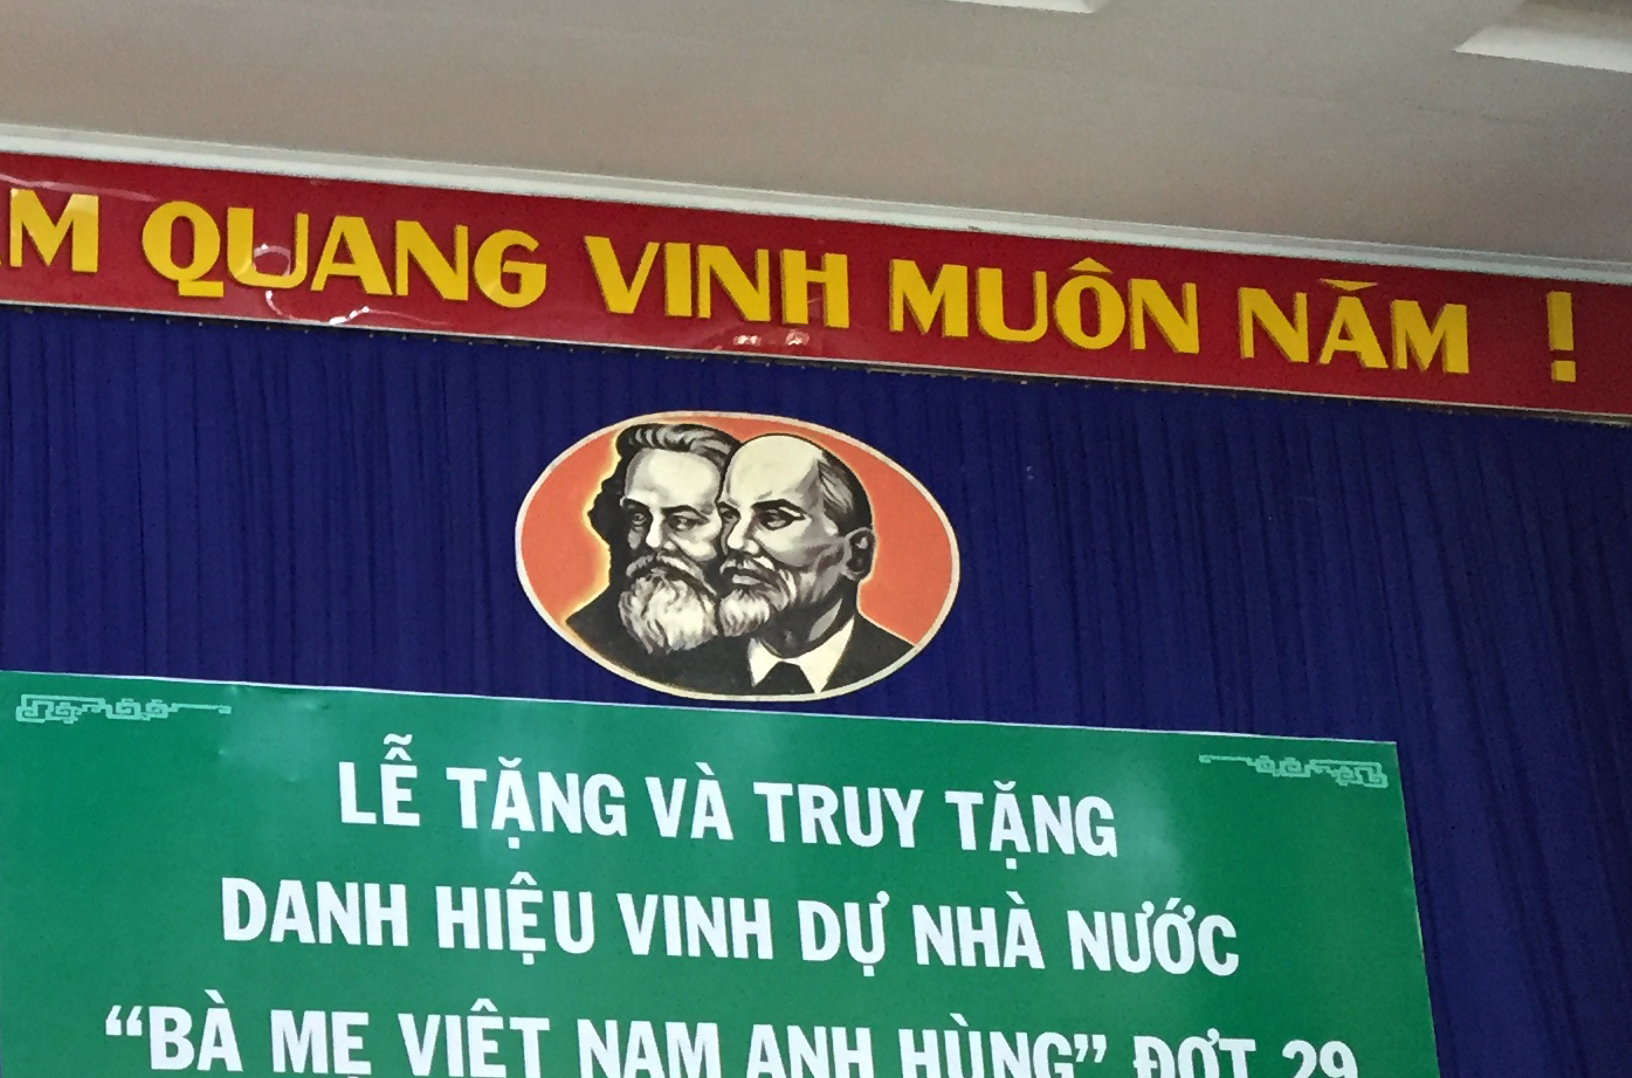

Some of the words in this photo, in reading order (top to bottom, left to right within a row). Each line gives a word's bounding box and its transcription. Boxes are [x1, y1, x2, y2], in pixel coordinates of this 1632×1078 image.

[141, 200, 548, 308] QUANG
[584, 235, 850, 329] VINH
[890, 257, 1201, 354] MUÔN
[1239, 279, 1470, 374] NĂM
[338, 733, 421, 827] LỄ
[445, 755, 628, 850] TẶNG
[644, 761, 734, 841] VÀ
[752, 781, 924, 848] TRUY
[944, 780, 1118, 870] TẶNG
[221, 877, 409, 947] DANH
[435, 870, 596, 966] HIỆU
[616, 892, 774, 960] VINH
[797, 890, 890, 977] DỰ
[912, 890, 1046, 970] NHÀ
[1066, 897, 1239, 976] NƯỚC
